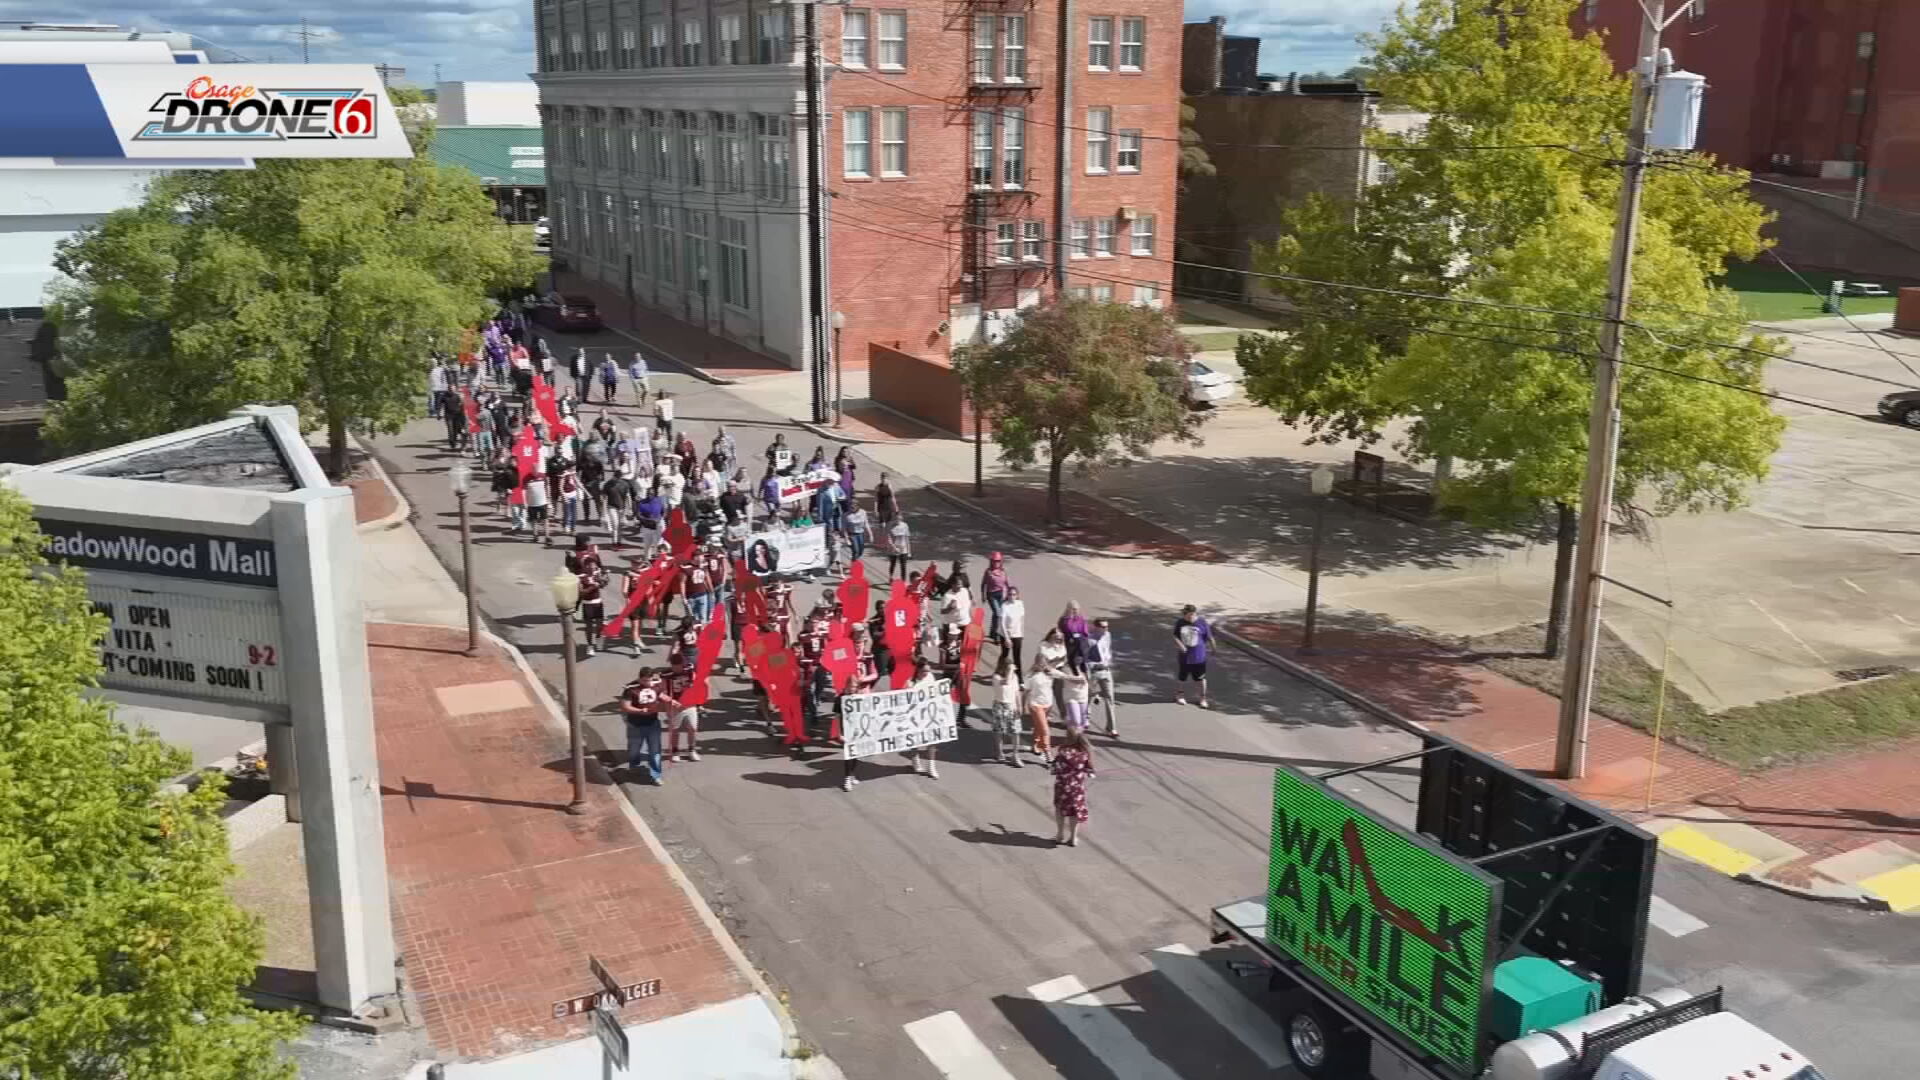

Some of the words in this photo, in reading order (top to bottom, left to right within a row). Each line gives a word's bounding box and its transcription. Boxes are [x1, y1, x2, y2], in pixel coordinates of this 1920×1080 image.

[42, 530, 197, 569] adowWood
[208, 540, 271, 577] Mall
[128, 605, 171, 629] OPEN
[113, 628, 156, 653] VITA
[1316, 877, 1475, 1031] MILE
[592, 981, 657, 1010] OKLGEE
[1273, 909, 1297, 945] IN
[1302, 931, 1359, 988] HER
[1364, 974, 1470, 1064] SHOES
